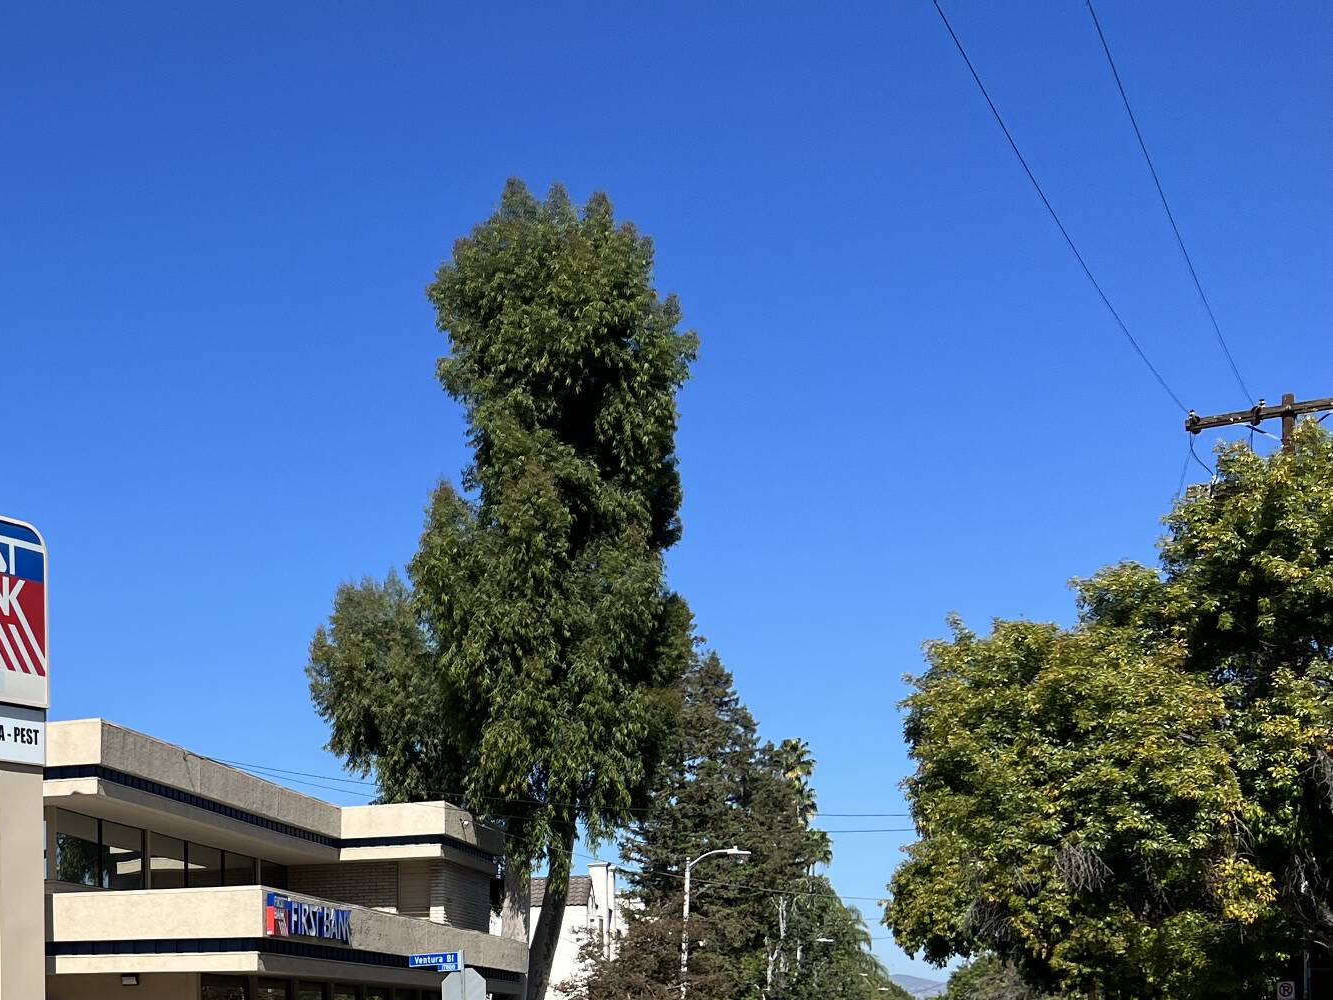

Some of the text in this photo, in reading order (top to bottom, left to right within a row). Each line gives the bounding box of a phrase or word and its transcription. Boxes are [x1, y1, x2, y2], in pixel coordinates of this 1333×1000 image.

[13, 726, 39, 746] PEST
[291, 901, 352, 945] FIRST BANK
[414, 954, 454, 965] Ventura Bl
